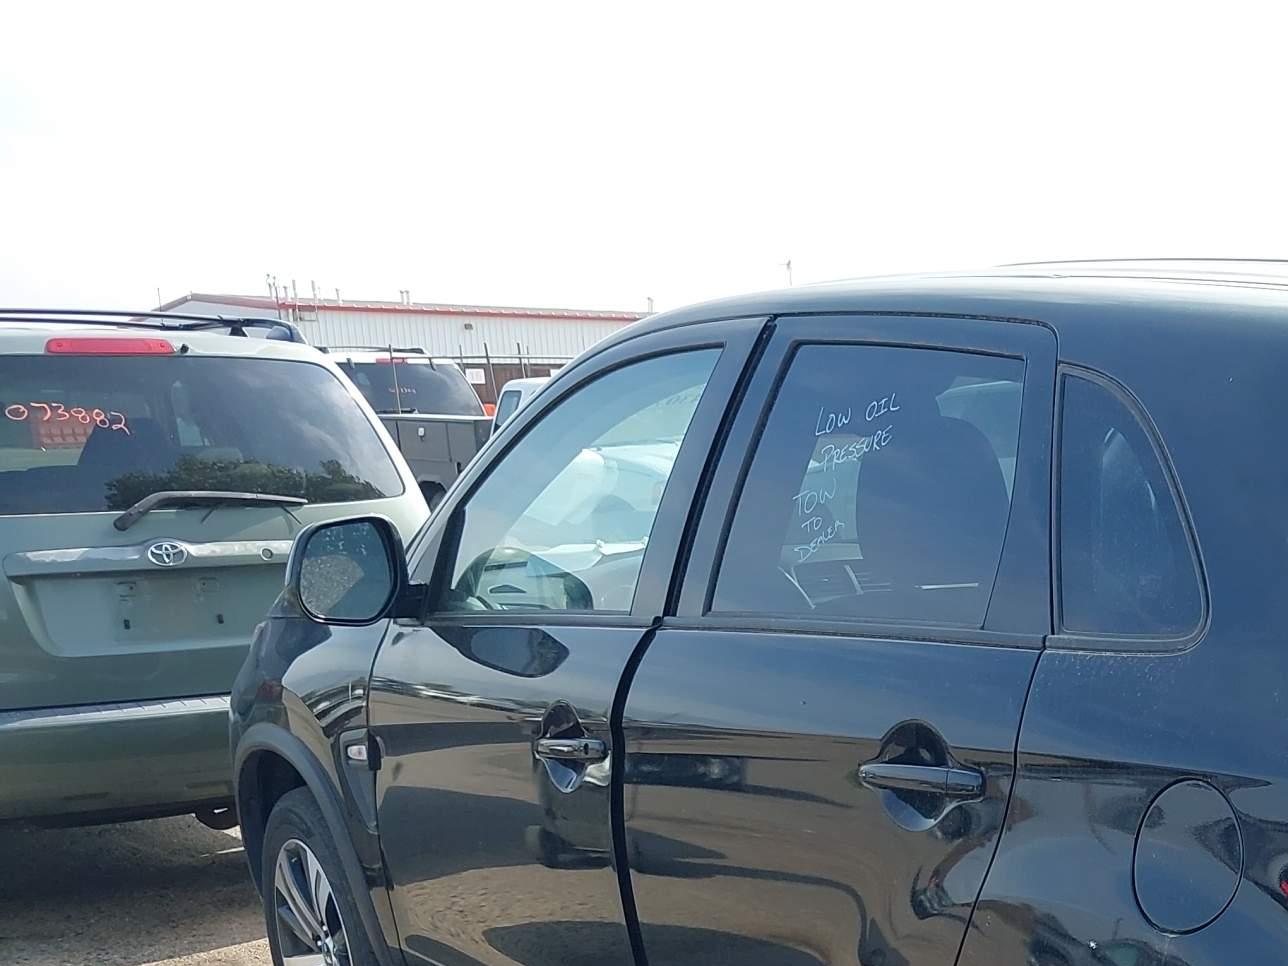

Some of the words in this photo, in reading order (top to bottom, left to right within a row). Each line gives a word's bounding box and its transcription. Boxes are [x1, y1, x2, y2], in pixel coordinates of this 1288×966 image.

[4, 401, 131, 435] 073882
[815, 407, 852, 436] LOW
[865, 392, 901, 421] OIL
[821, 424, 894, 472] PRESSURE
[792, 478, 836, 516] TOW
[801, 516, 823, 534] TO
